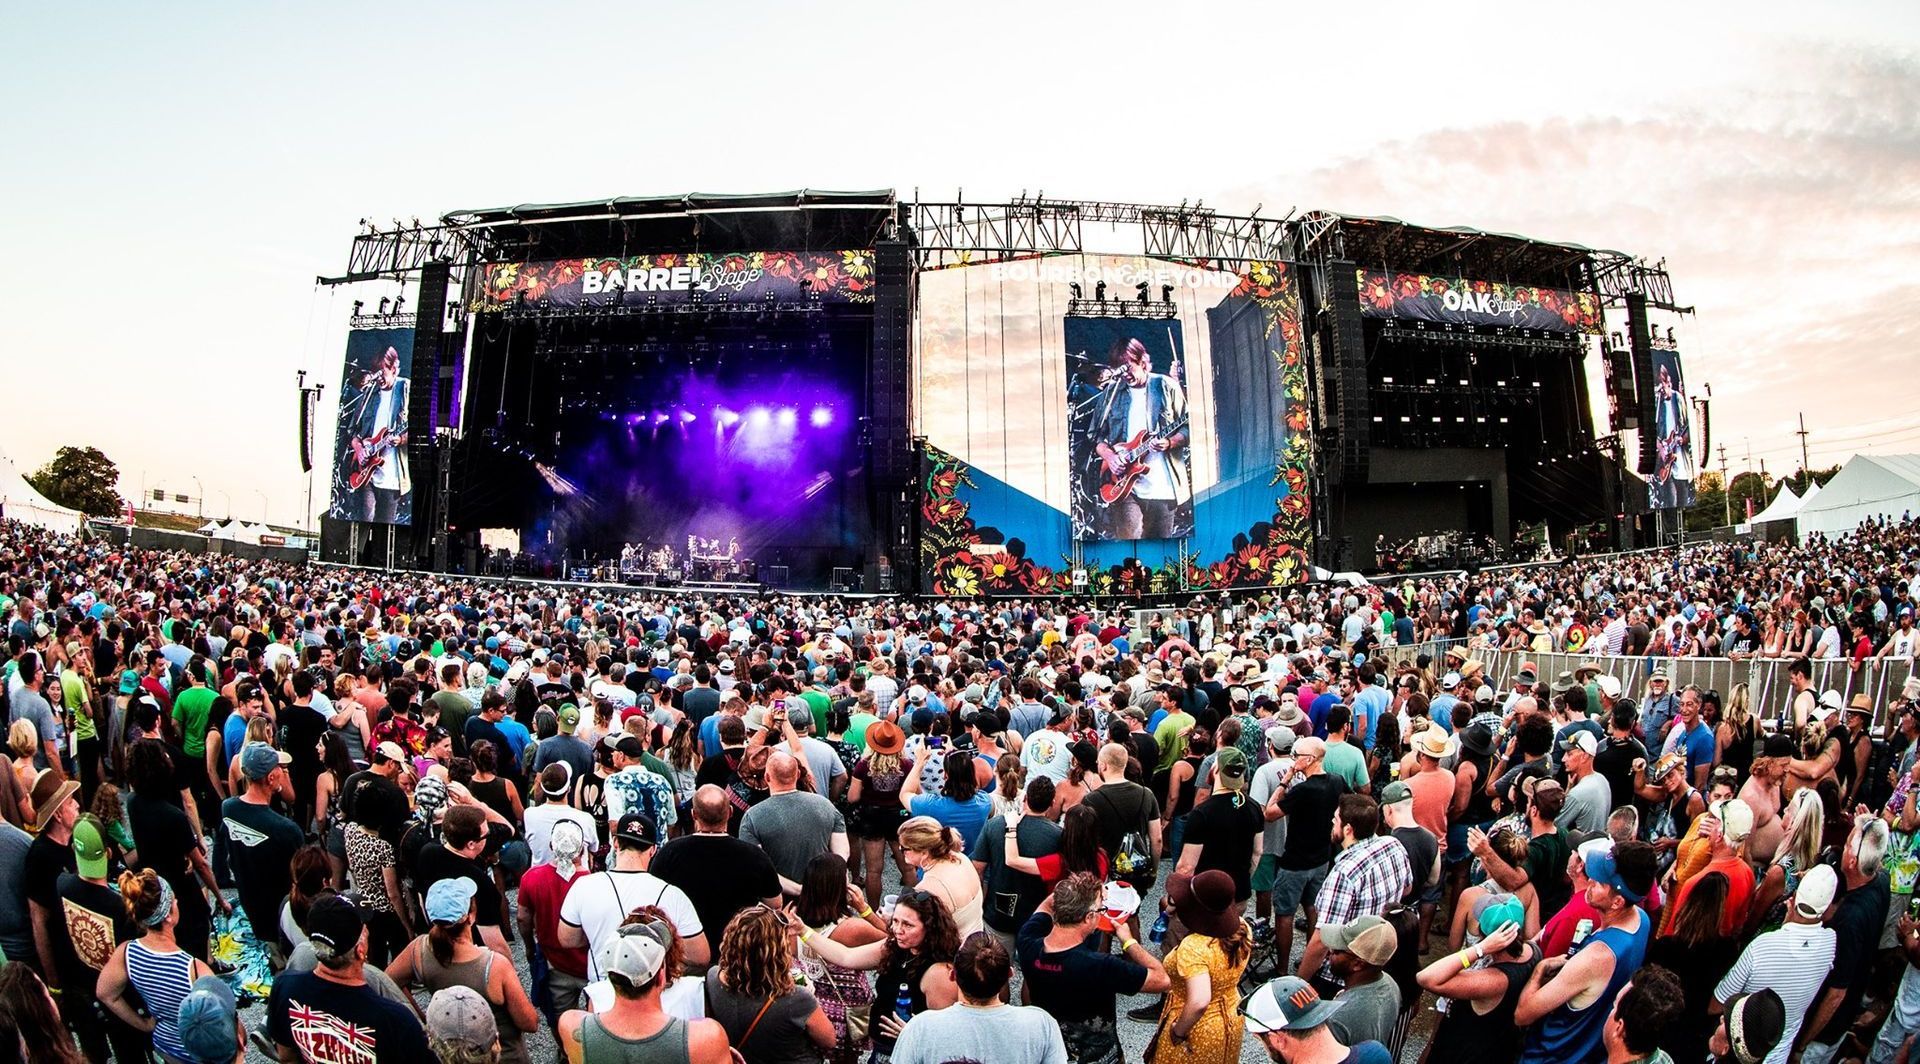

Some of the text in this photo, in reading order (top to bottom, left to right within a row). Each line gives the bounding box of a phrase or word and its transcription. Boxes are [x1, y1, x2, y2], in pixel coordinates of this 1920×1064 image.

[582, 264, 761, 294] BARREL Stage
[990, 262, 1121, 285] BOURBON
[1138, 267, 1241, 289] BEYOND
[1443, 289, 1524, 317] OAK Stage
